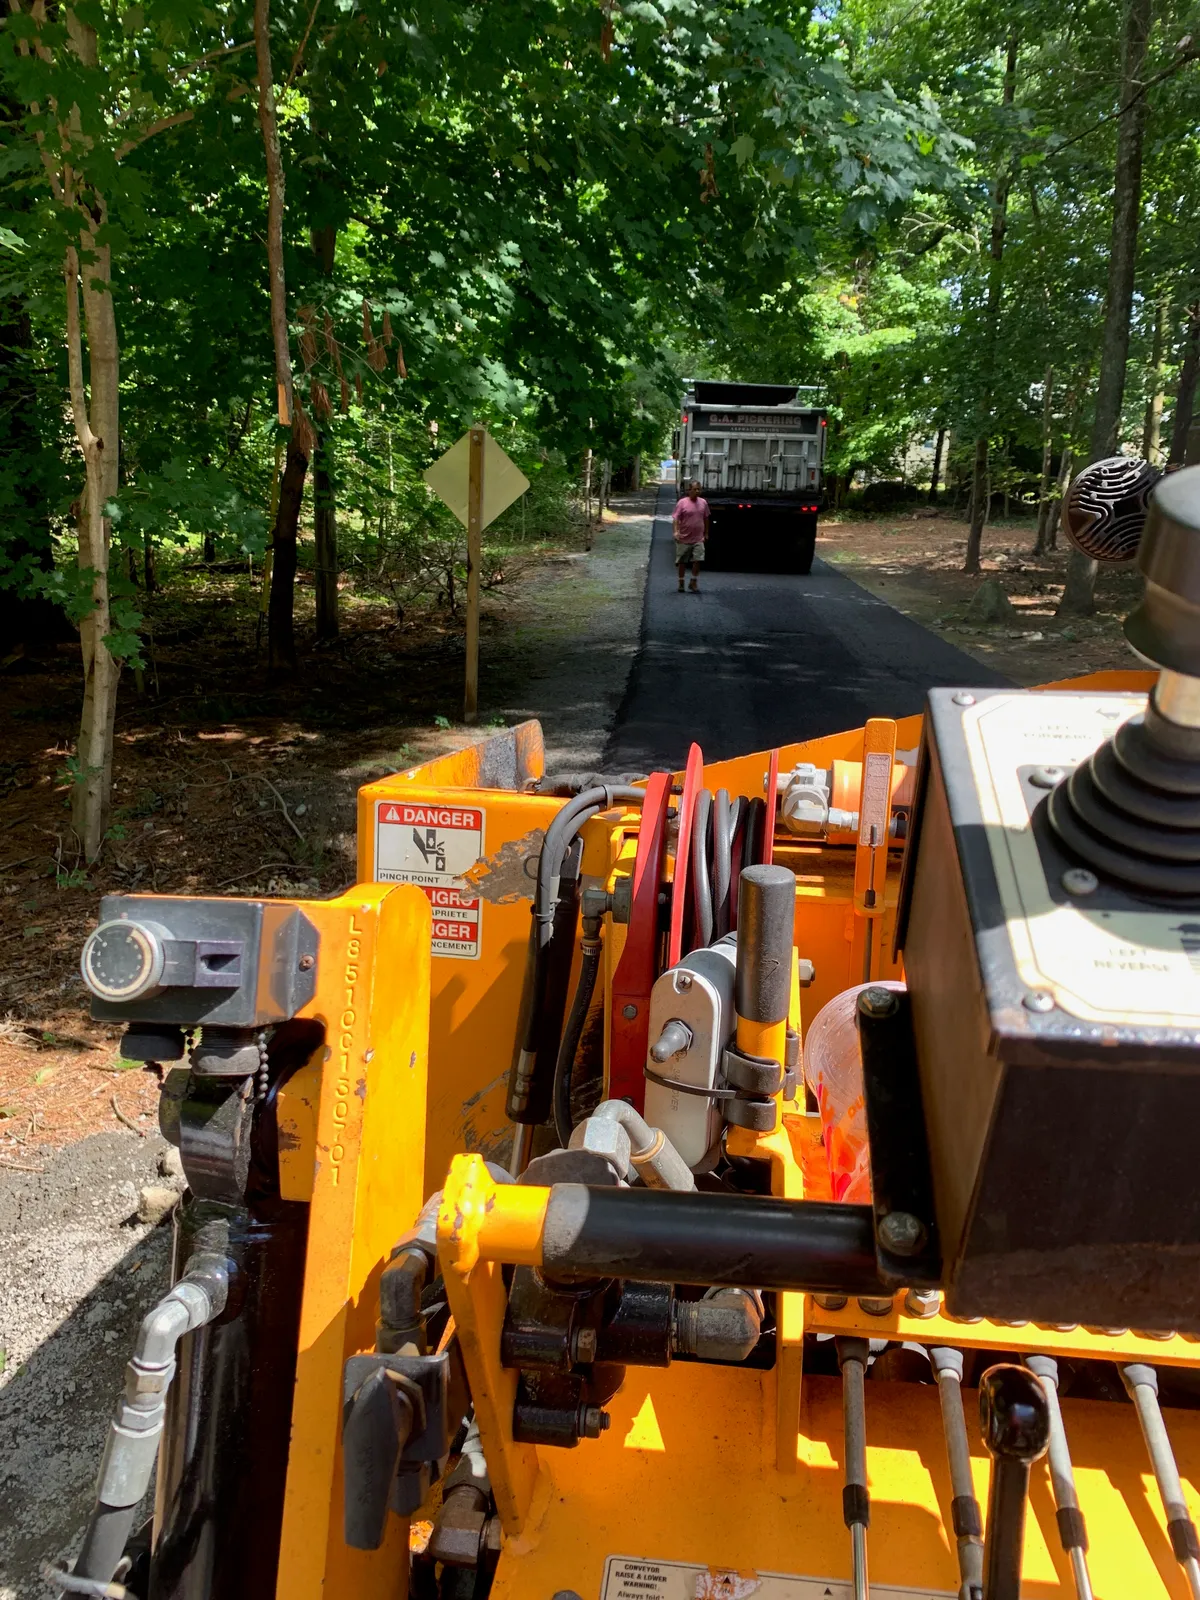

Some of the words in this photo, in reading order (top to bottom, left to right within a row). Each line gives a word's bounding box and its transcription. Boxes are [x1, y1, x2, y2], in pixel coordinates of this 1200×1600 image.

[709, 414, 733, 422] G.A.
[737, 415, 801, 425] PICKERING
[404, 808, 475, 827] DANGER
[379, 872, 409, 881] PINCH
[411, 875, 440, 883] POINT
[431, 941, 473, 951] NCEMENT
[1093, 959, 1170, 972] REVERSE
[624, 1563, 660, 1573] CONVEYOR
[615, 1571, 635, 1579] RAISE
[644, 1574, 668, 1582] LOWER
[623, 1580, 658, 1590] WARNING!
[617, 1590, 643, 1600] Always
